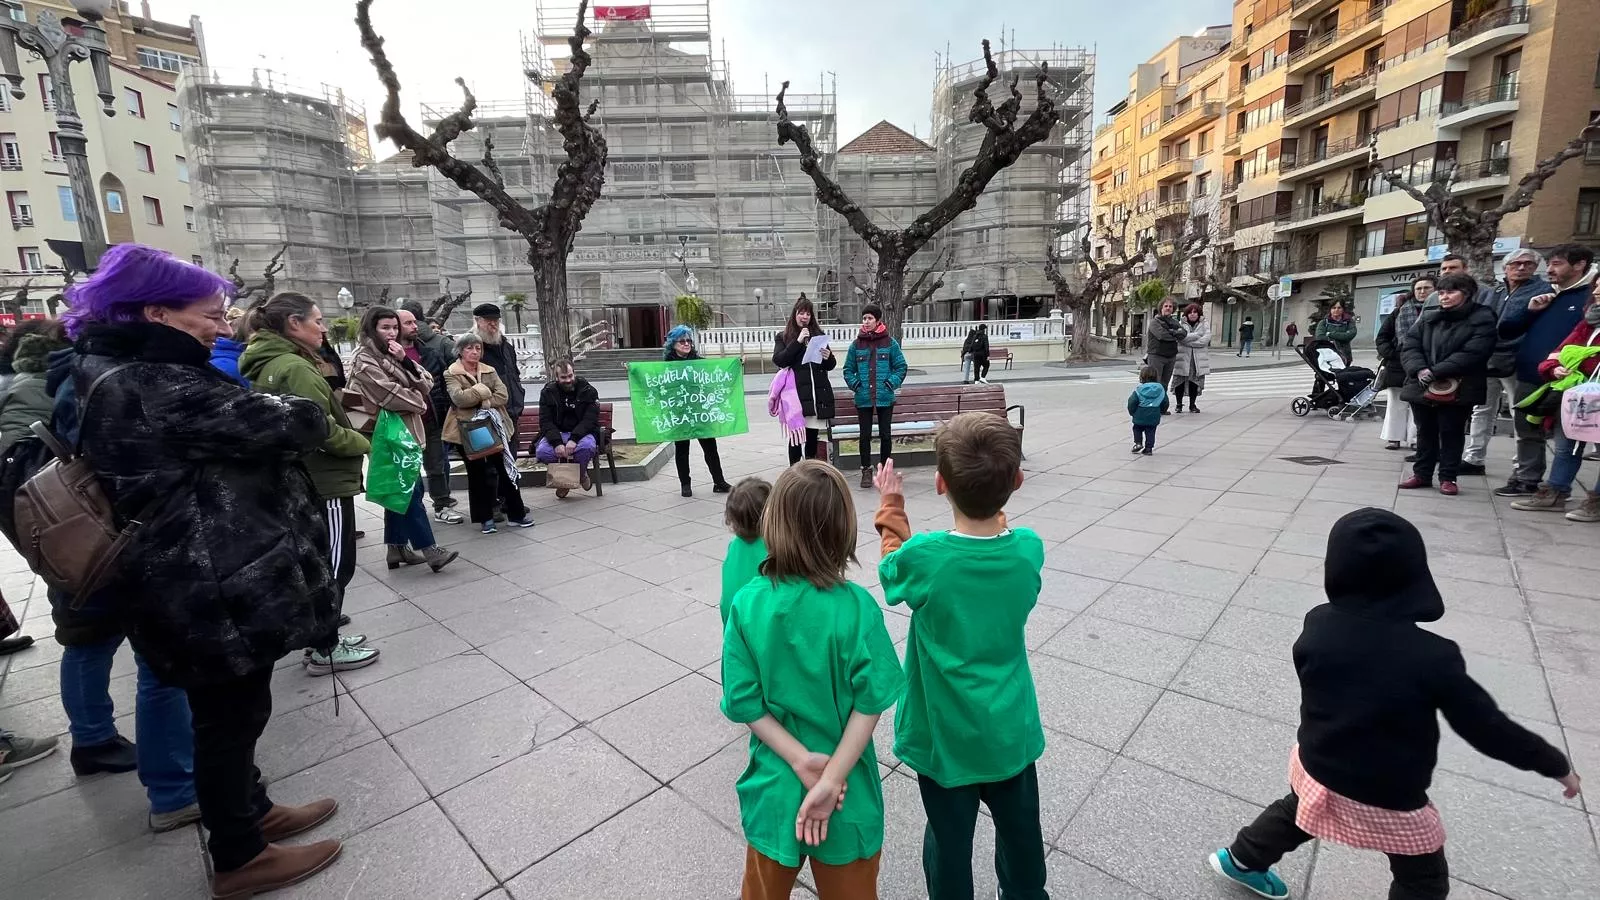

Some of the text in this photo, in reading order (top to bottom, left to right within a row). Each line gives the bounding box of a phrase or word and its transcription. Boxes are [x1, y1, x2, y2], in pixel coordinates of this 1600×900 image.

[646, 369, 689, 387] ESCUELA
[660, 397, 676, 409] DE
[656, 414, 690, 430] PARA
